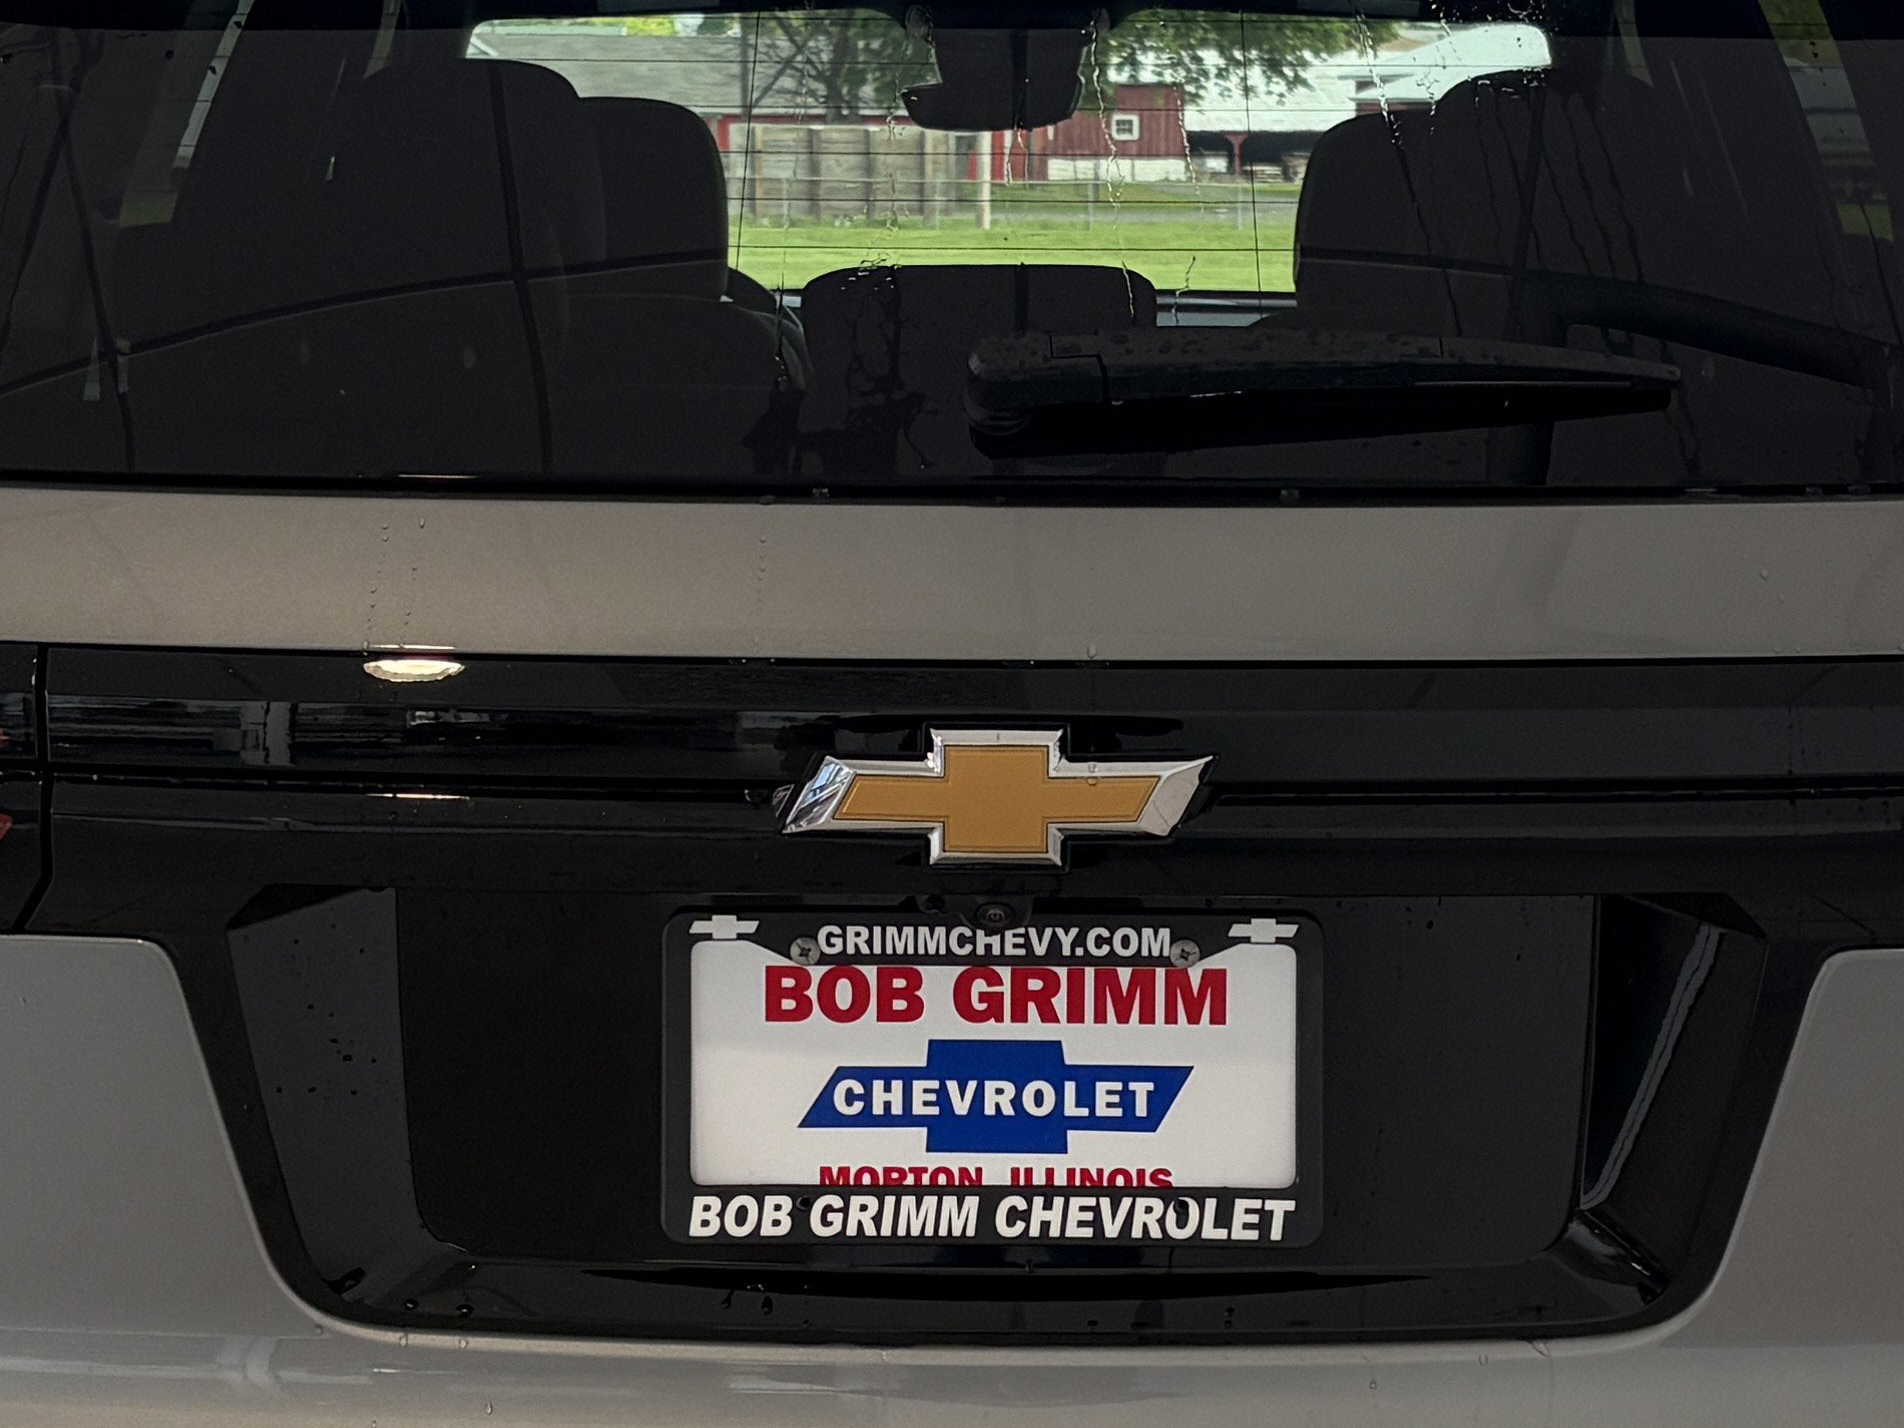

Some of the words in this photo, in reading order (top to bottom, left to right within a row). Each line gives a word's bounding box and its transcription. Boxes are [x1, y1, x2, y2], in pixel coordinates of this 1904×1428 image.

[817, 925, 1170, 957] GRIMMCHEVY.COM
[765, 966, 924, 1023] BOB
[952, 967, 1227, 1026] GRIMM
[832, 1078, 1154, 1118] CHEVROLET
[689, 1195, 794, 1238] BOB
[808, 1195, 979, 1239] GRIMM
[994, 1195, 1296, 1242] CHEVROLET
